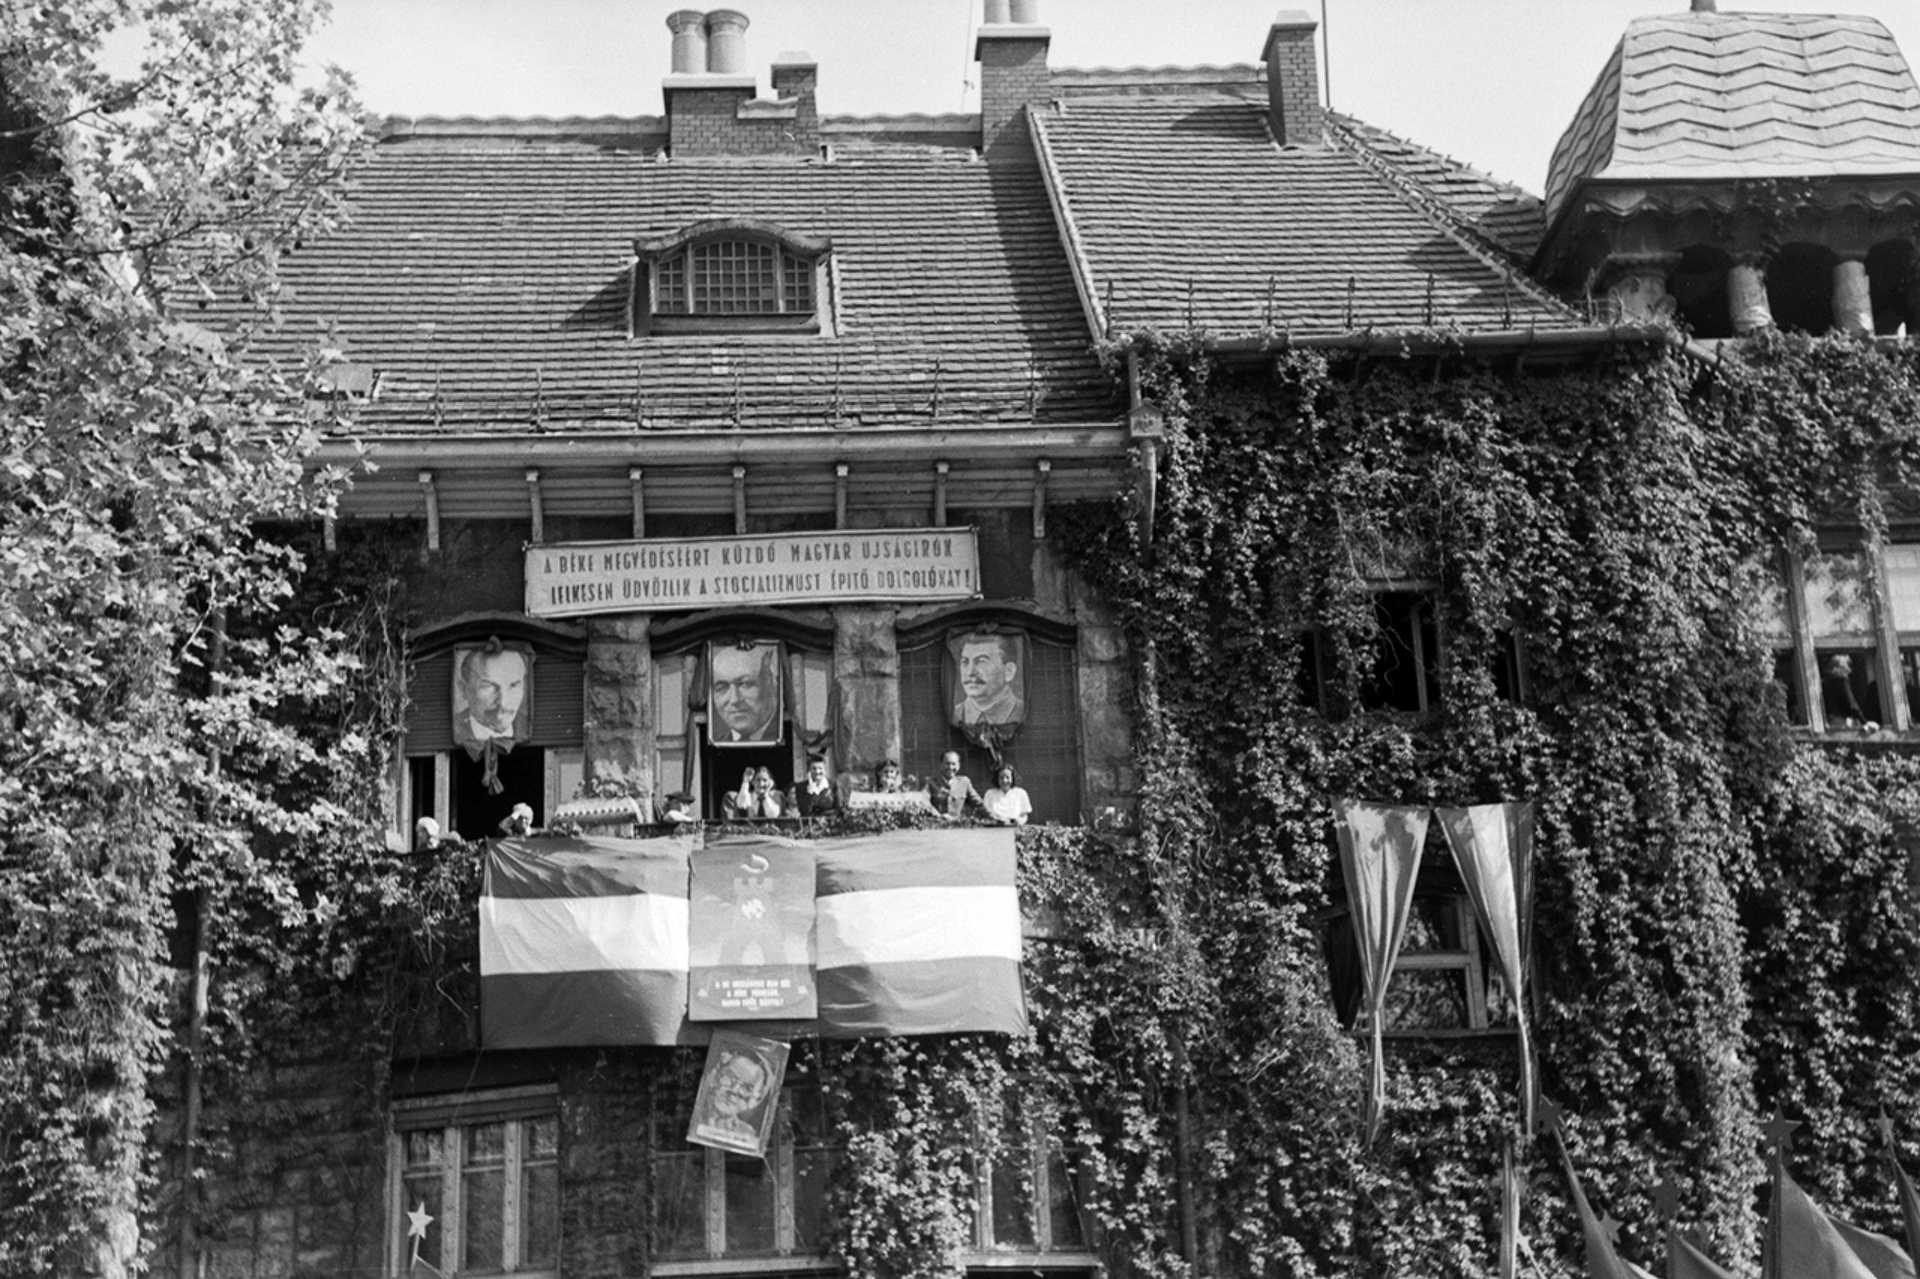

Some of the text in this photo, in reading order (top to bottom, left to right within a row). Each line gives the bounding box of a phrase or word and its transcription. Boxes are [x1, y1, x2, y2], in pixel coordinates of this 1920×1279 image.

[544, 557, 552, 573] A
[559, 552, 593, 574] BÉKE
[791, 542, 851, 562] MAGYAR
[551, 582, 613, 605] LELKESEN
[623, 577, 690, 599] ÜDVÖZLIK
[700, 578, 707, 595] A
[714, 573, 820, 594] SZOCIALIZMUST
